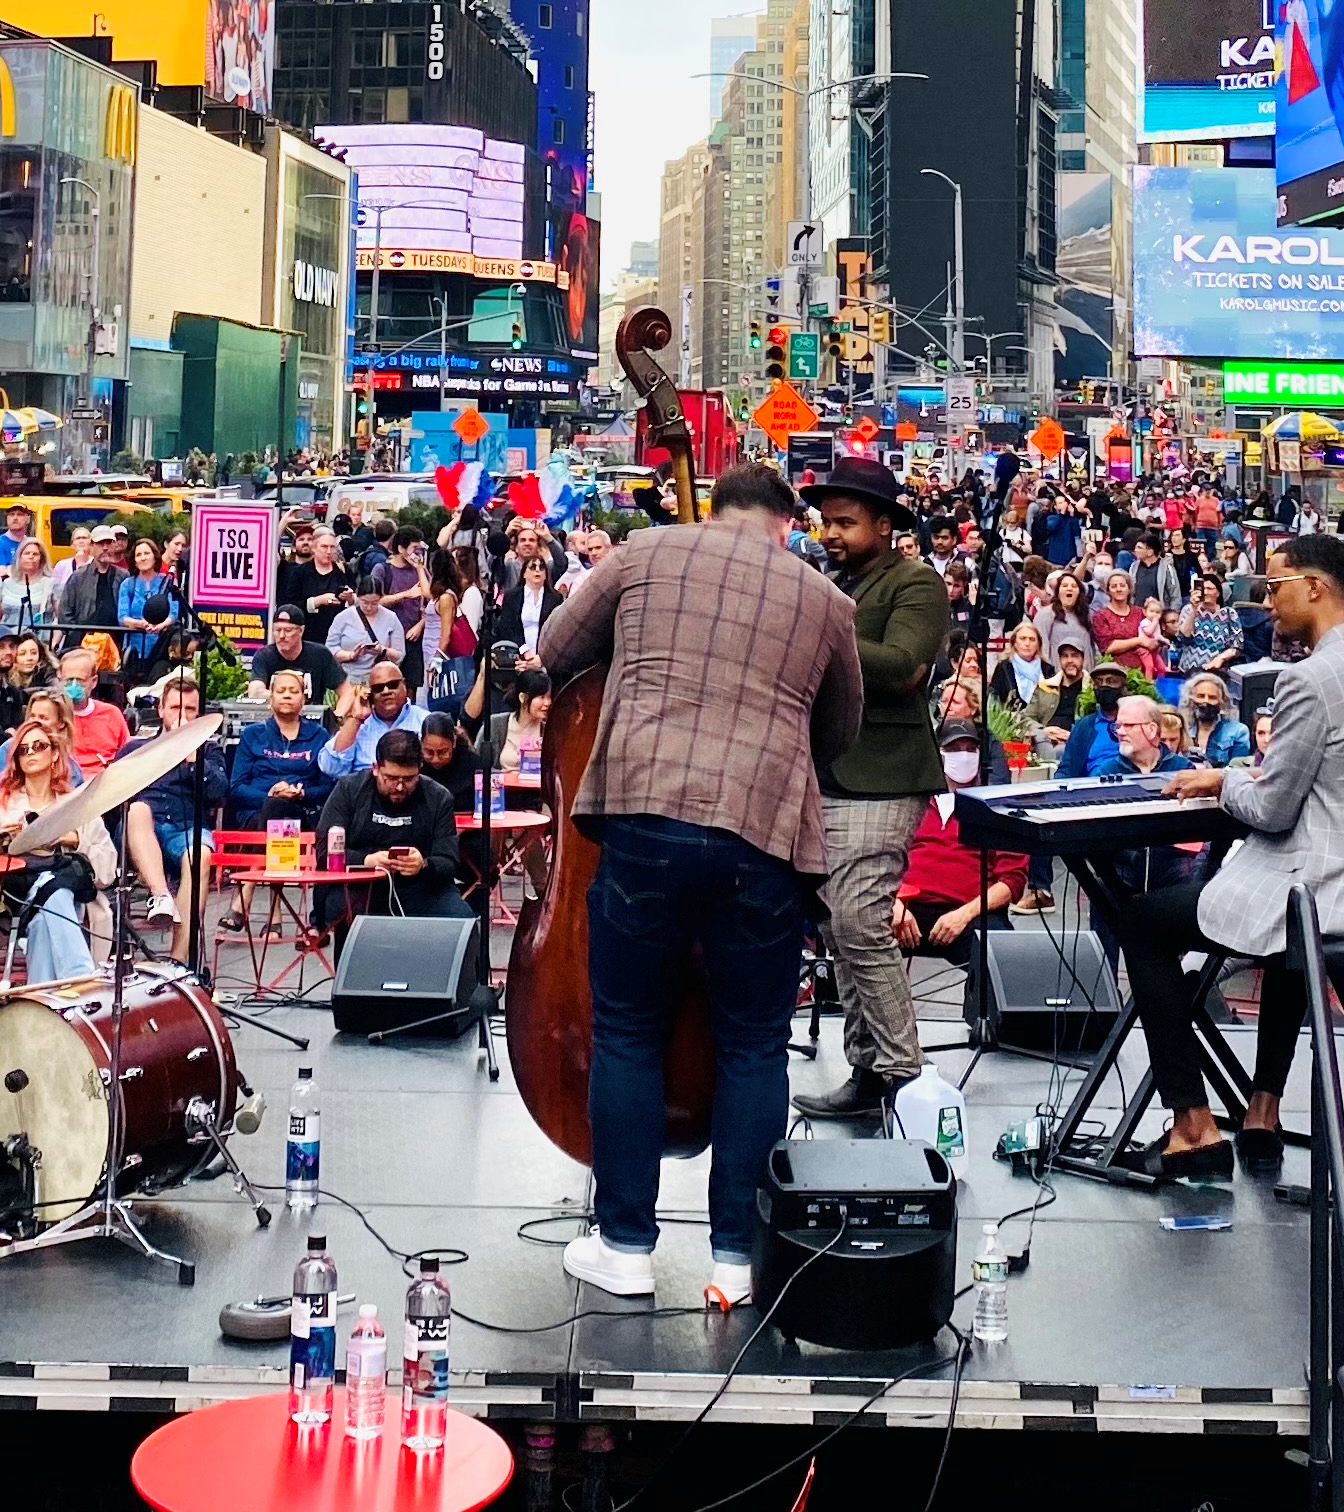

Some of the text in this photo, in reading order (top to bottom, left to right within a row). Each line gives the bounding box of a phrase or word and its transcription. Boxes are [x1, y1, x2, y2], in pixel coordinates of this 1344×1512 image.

[428, 4, 445, 80] 1500
[411, 254, 467, 270] TUESDAYS
[791, 253, 817, 262] ONLY
[473, 259, 515, 276] QUEENS
[294, 260, 339, 308] OLD NAVY
[1192, 271, 1273, 290] TICKETS
[1278, 273, 1303, 290] ON
[400, 354, 422, 369] big
[501, 357, 542, 373] NEWS
[412, 375, 440, 388] NBA
[483, 378, 502, 391] for
[950, 396, 972, 409] 25
[770, 423, 800, 431] AHEAD
[217, 529, 249, 549] TSQ
[211, 551, 254, 580] LIVE
[218, 612, 234, 625] LIVE
[432, 670, 459, 699] GAP
